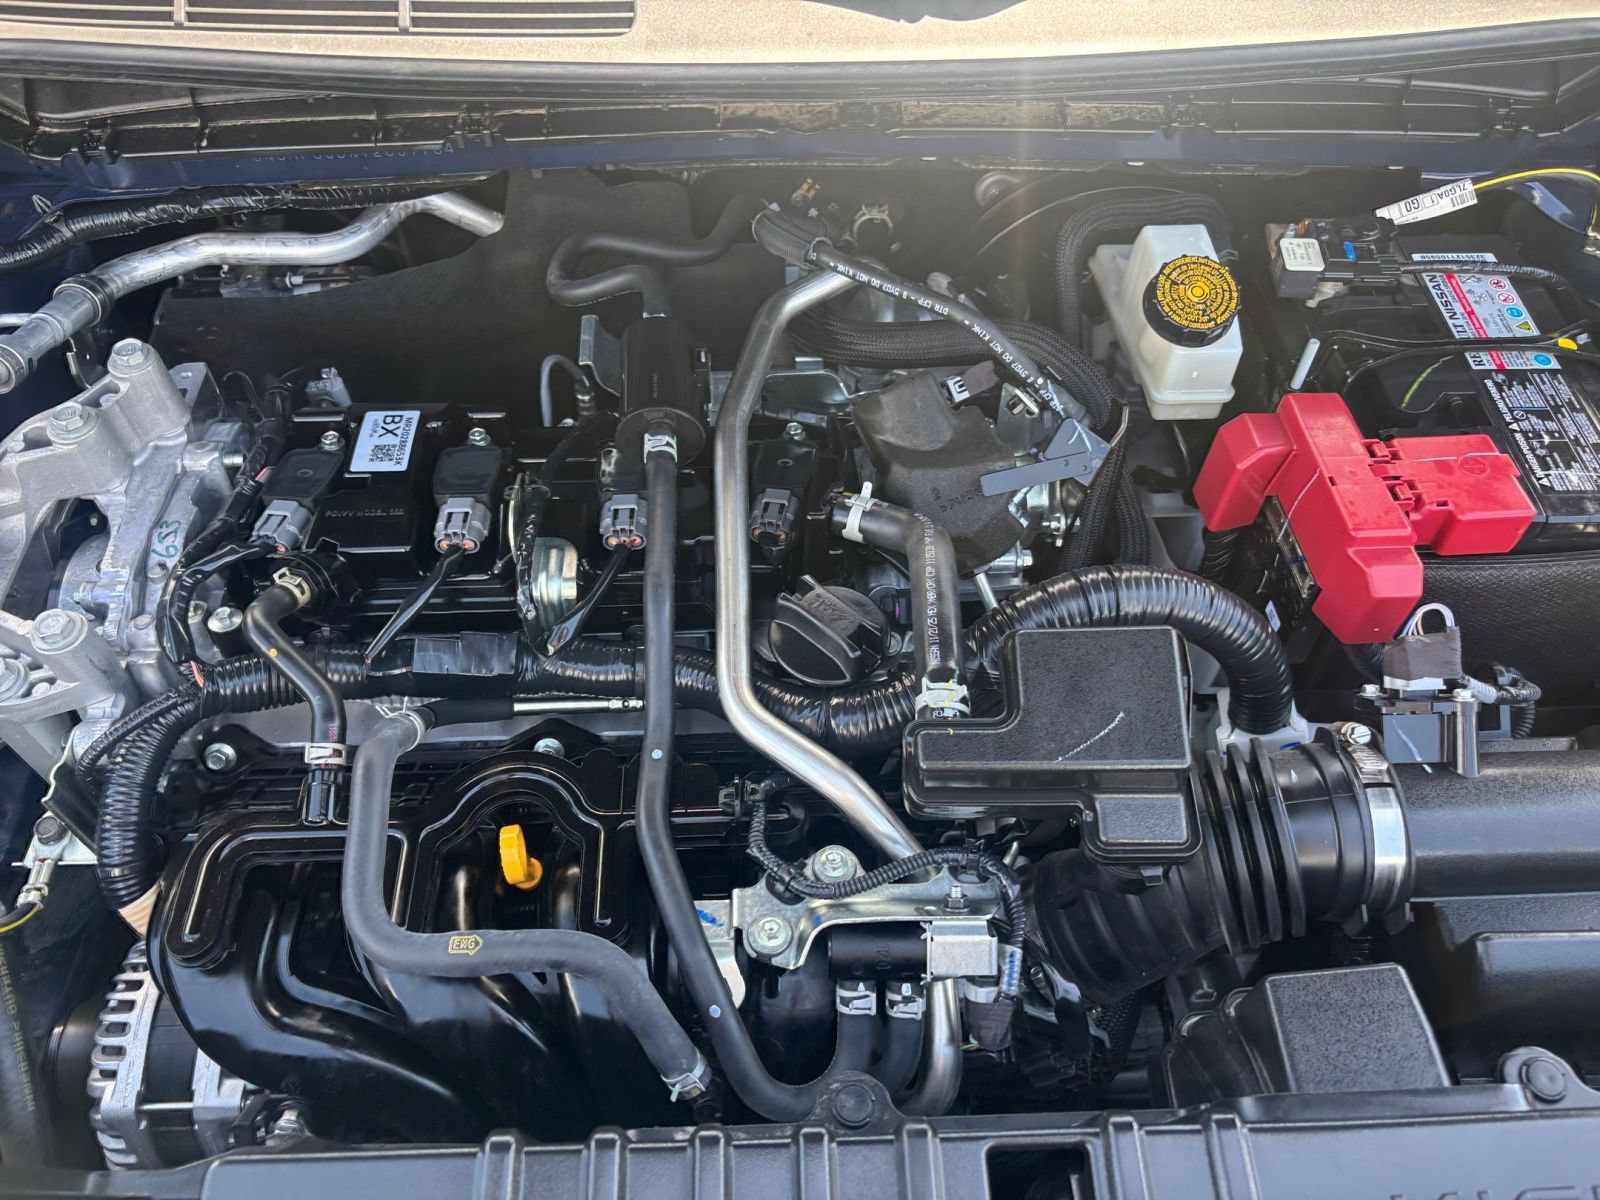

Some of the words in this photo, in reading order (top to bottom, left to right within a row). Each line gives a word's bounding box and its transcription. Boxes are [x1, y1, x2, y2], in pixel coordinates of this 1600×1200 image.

[837, 263, 853, 277] KINK
[856, 271, 868, 284] NOT
[1426, 274, 1460, 320] NISSAN
[971, 323, 991, 341] KINK
[989, 340, 1004, 354] NOT
[378, 414, 404, 438] BX
[452, 938, 476, 950] ENG
